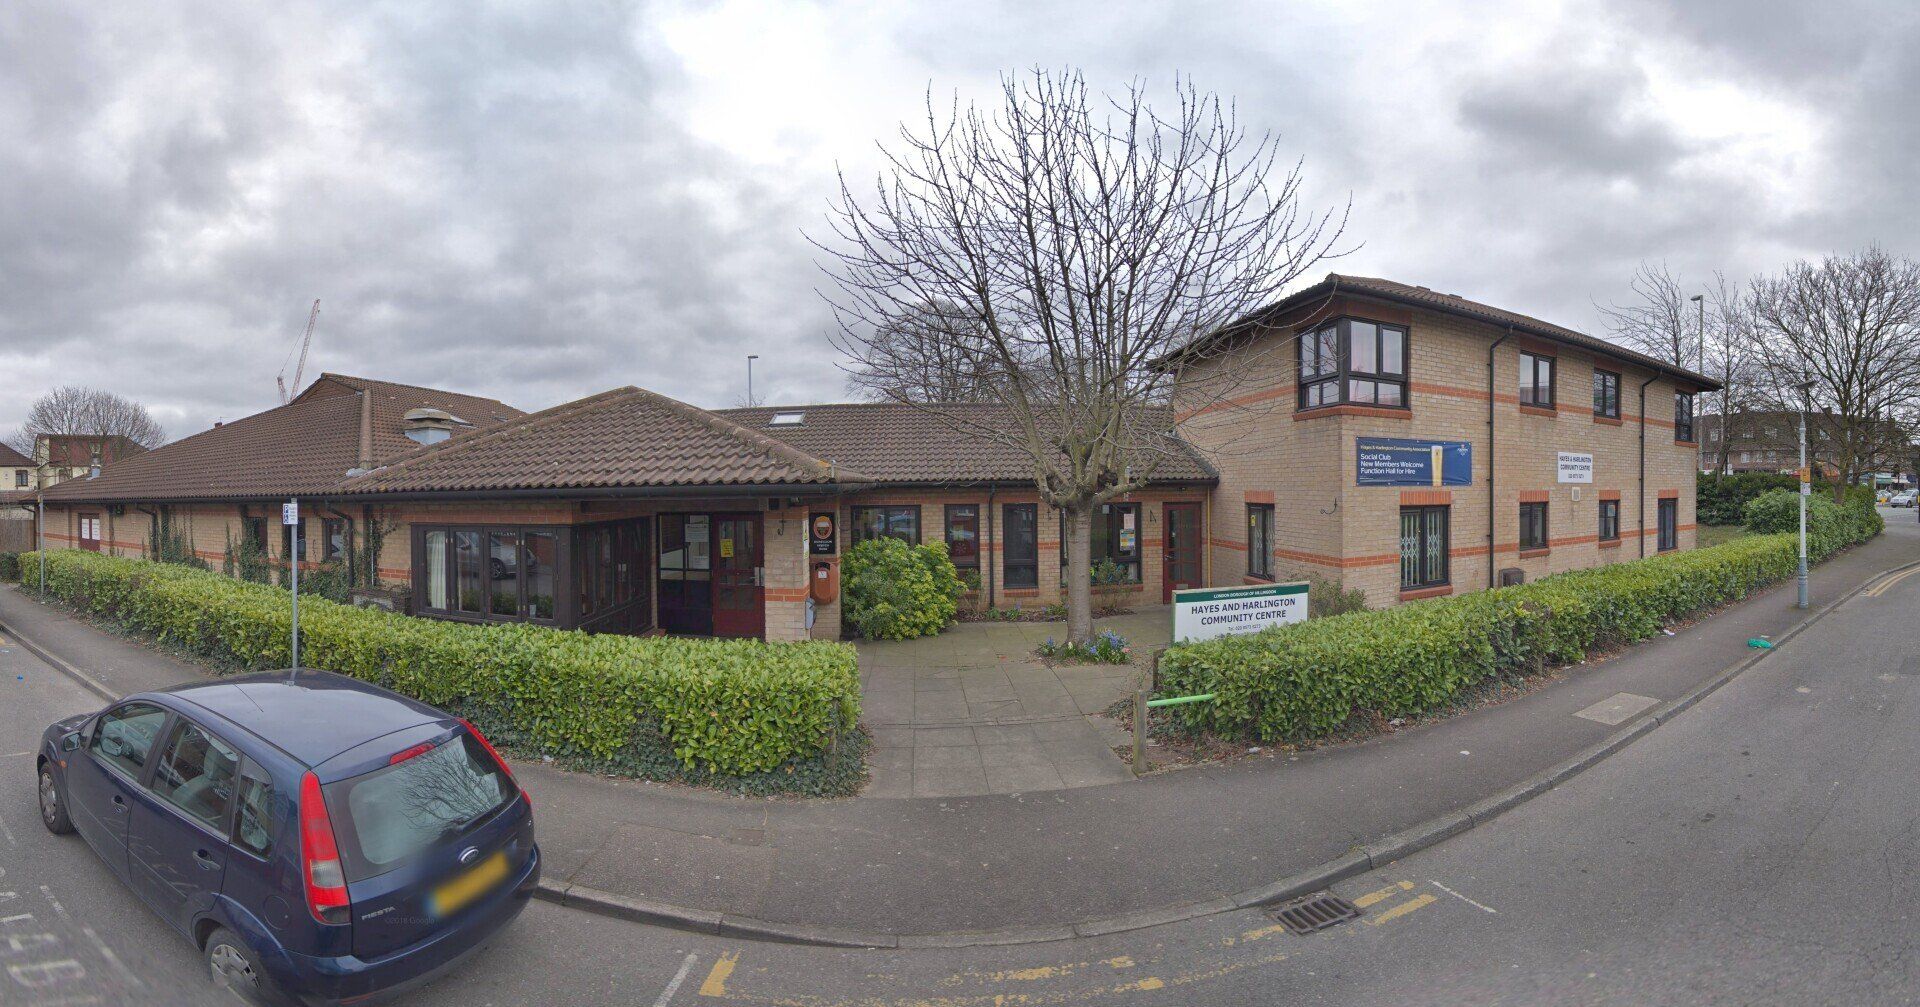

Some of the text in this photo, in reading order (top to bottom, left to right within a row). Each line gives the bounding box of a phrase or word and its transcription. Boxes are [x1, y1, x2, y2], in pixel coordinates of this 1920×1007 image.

[1191, 598, 1296, 615] HAYES AND HARLINGTON
[1201, 610, 1287, 625] COMMUNITY CENTRE
[361, 906, 396, 921] FIESTA
